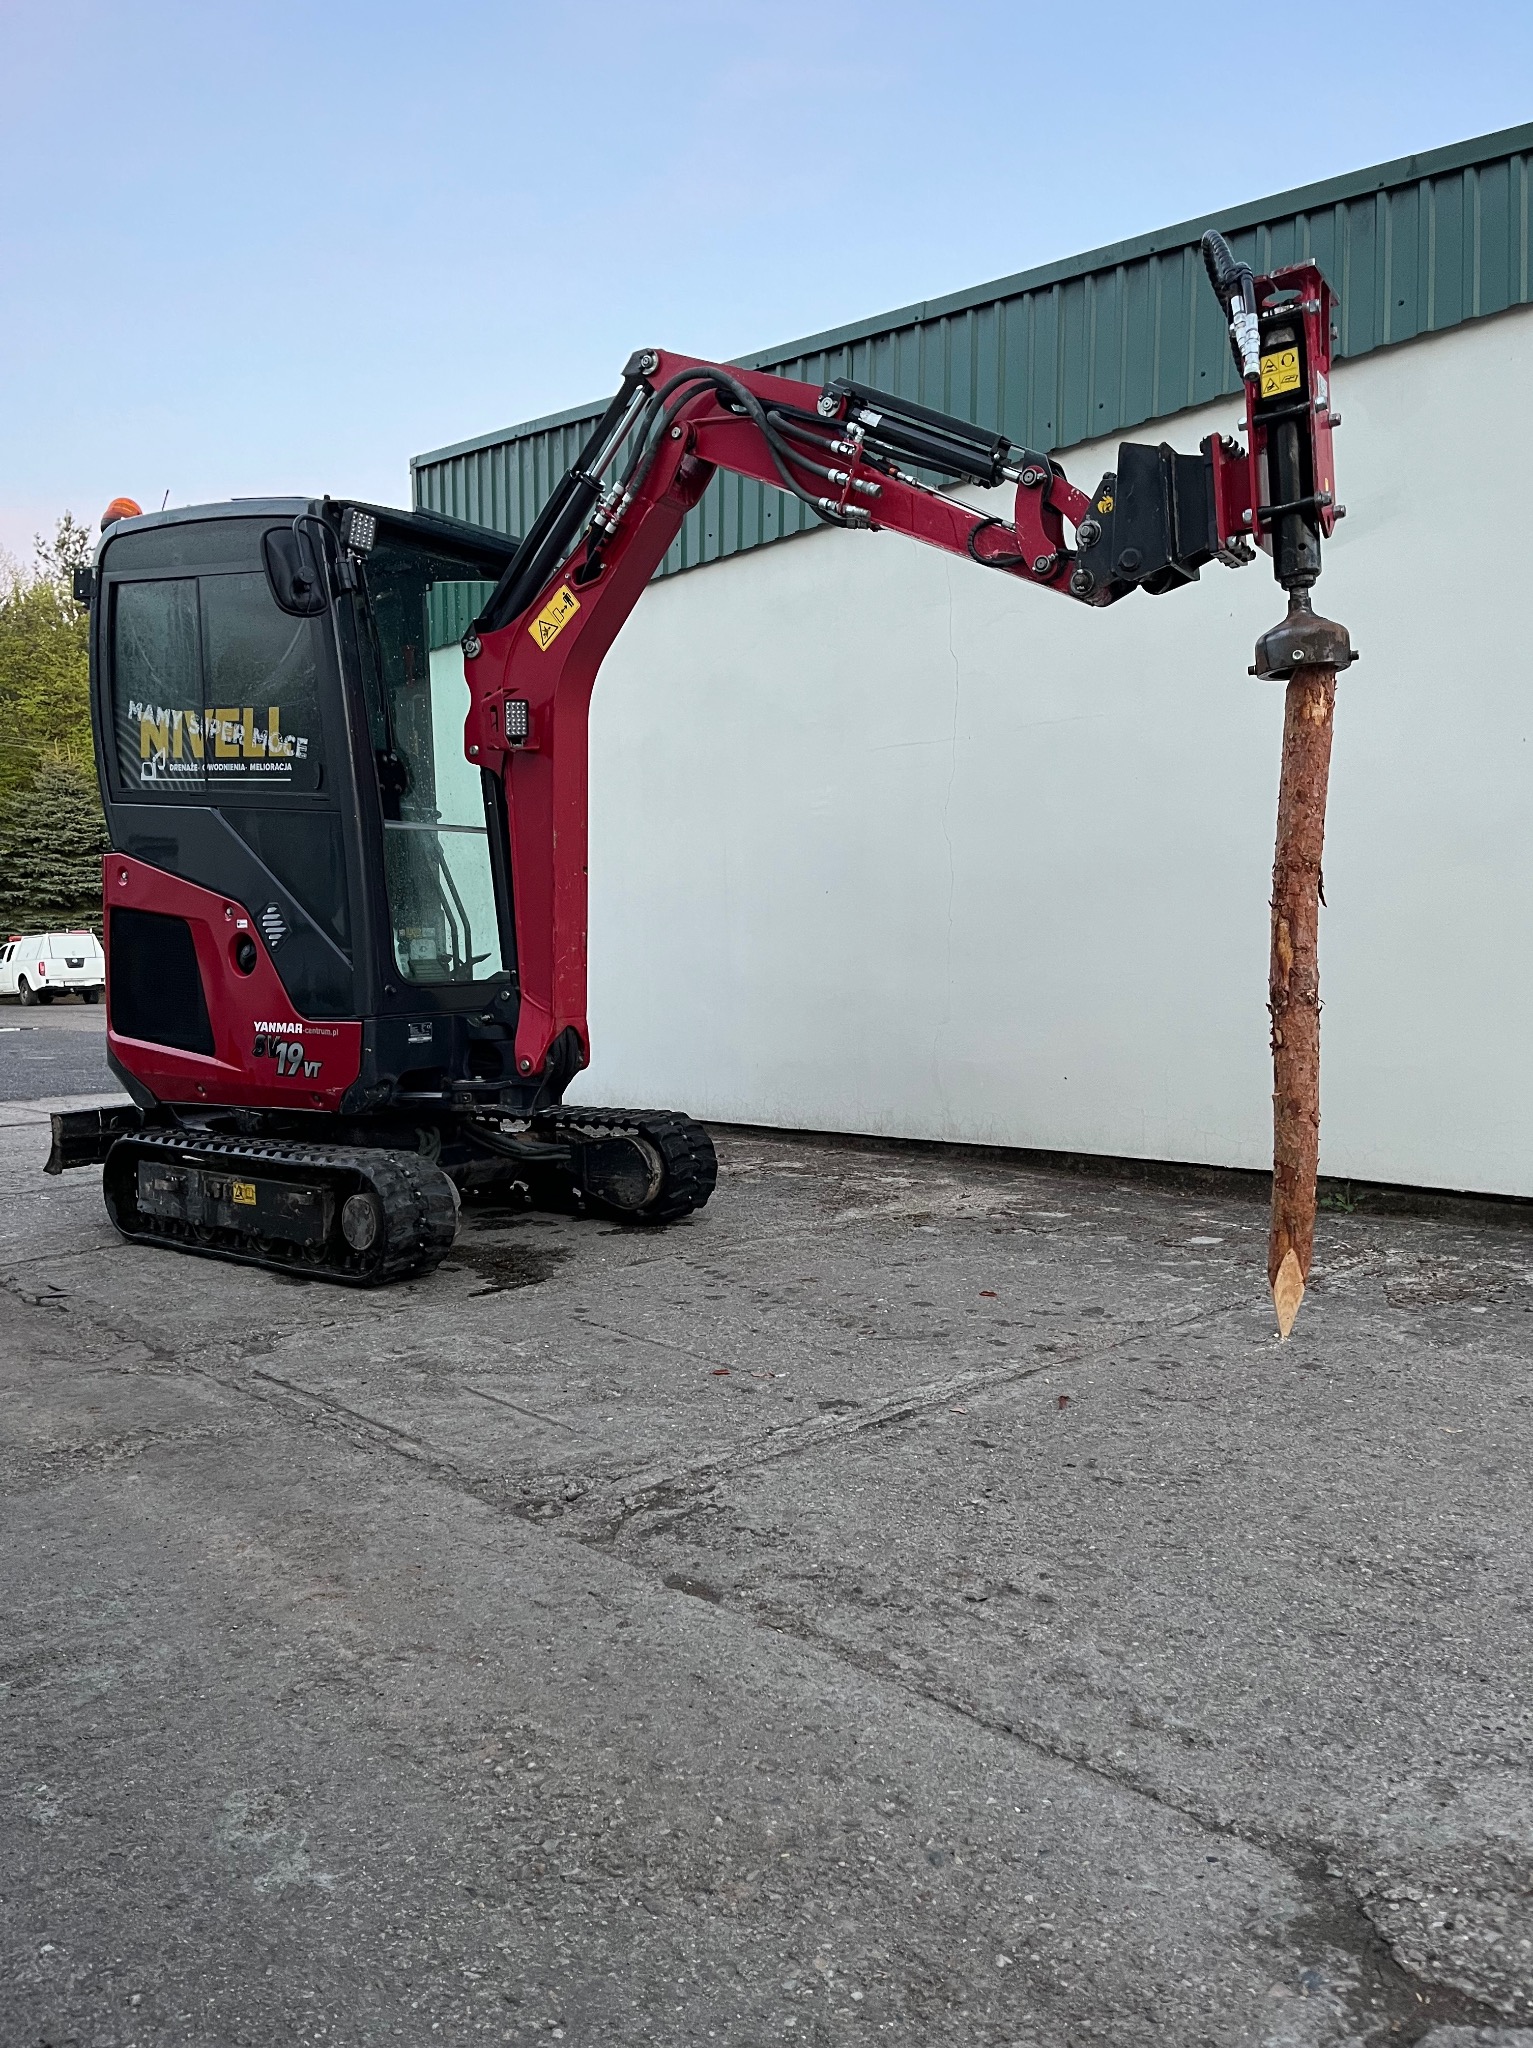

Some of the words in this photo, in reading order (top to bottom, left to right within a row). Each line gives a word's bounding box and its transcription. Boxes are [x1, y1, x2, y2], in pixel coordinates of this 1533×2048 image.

[128, 700, 182, 730] MAMY
[252, 727, 309, 760] MOCE
[140, 706, 291, 759] NIVELL
